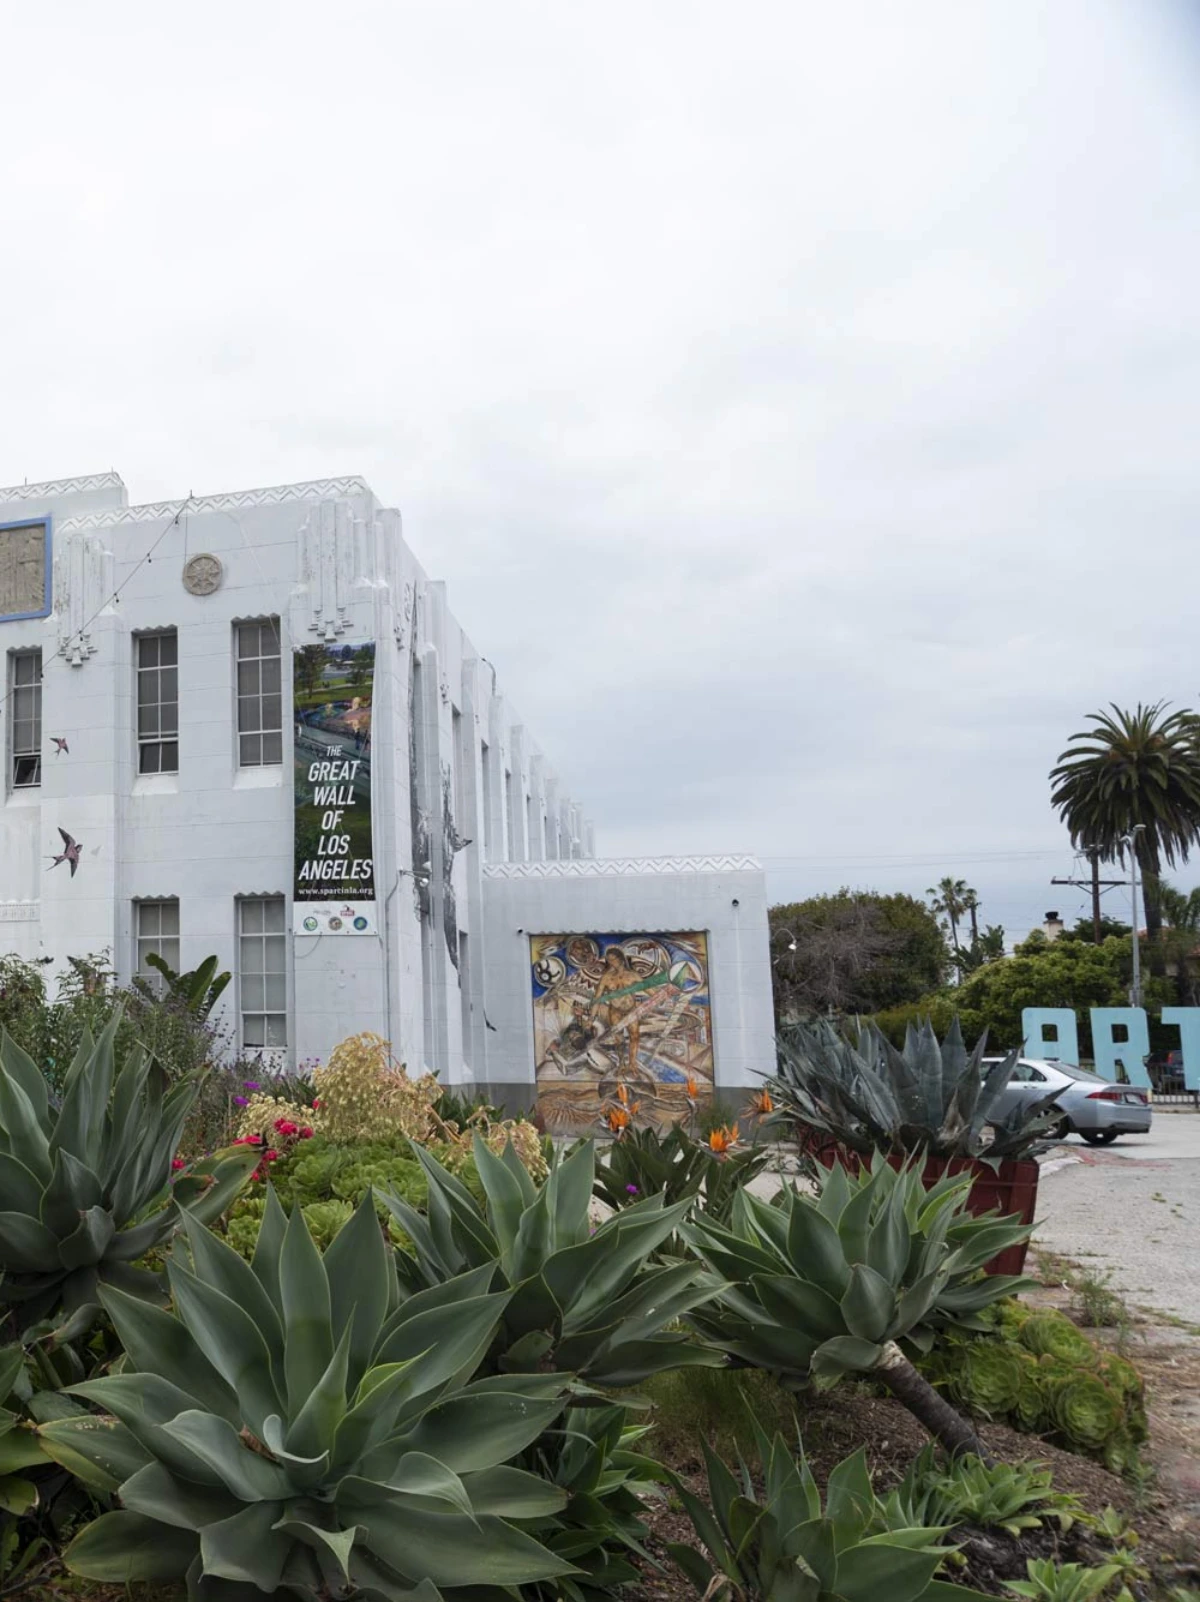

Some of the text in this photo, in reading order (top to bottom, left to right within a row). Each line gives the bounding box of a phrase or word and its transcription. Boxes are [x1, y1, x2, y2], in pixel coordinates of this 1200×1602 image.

[326, 745, 343, 756] THE
[307, 761, 360, 782] GREAT
[313, 785, 356, 806] WALL
[321, 810, 344, 830] OF
[317, 835, 350, 855] LOS
[298, 859, 373, 881] ANGELES
[298, 887, 373, 896] www.sparcinla.org
[1021, 1007, 1200, 1091] ART
